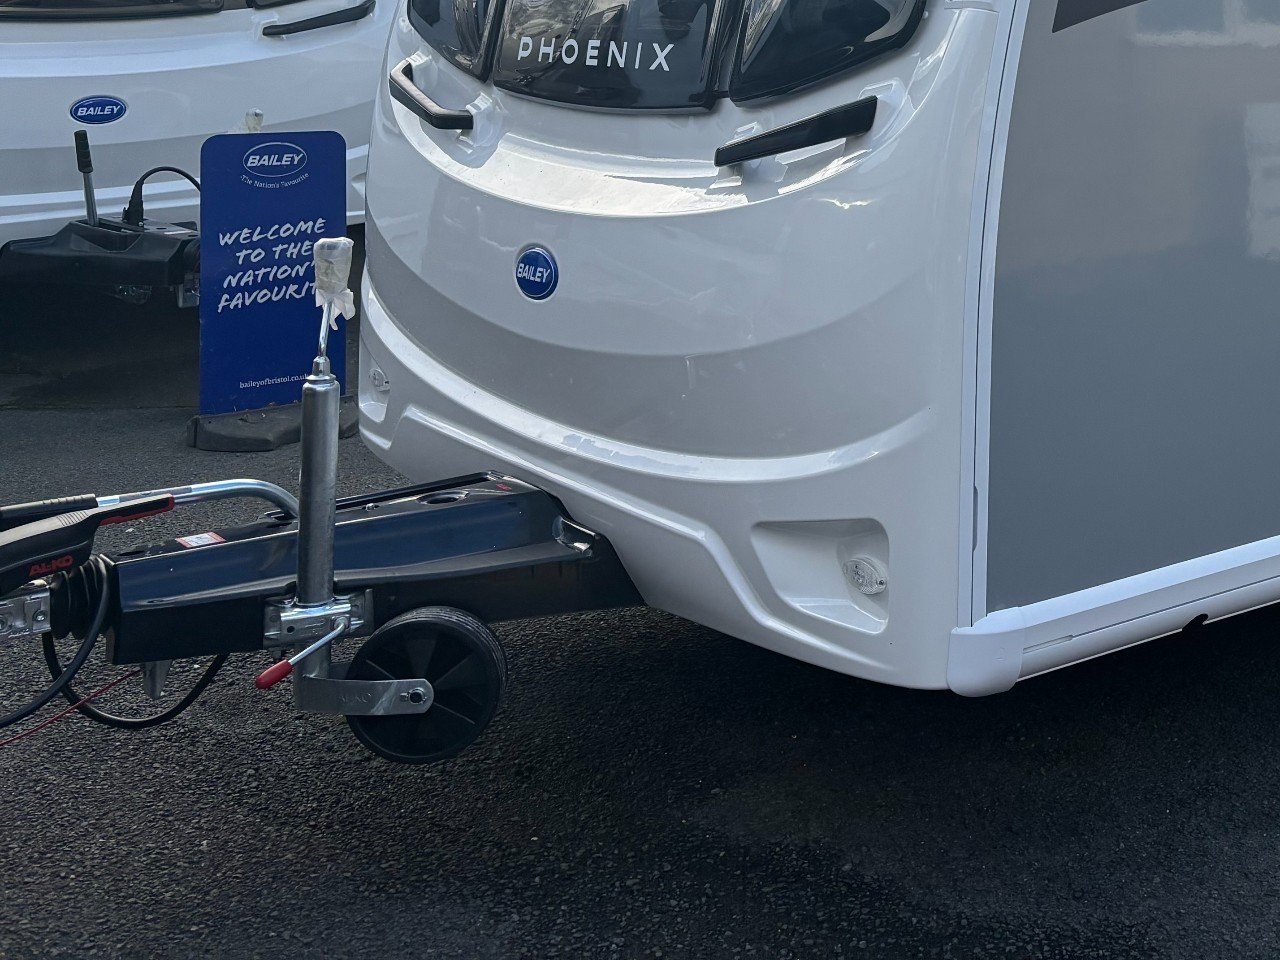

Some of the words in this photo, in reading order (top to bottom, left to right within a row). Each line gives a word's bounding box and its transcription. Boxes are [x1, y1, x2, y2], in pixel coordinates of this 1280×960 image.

[517, 36, 675, 72] PHOENIX
[77, 105, 120, 116] BAILEY
[246, 153, 304, 167] BAILEY
[219, 218, 326, 246] WELCOME
[236, 248, 266, 265] TO
[272, 240, 314, 260] THE
[223, 260, 315, 289] NATION'
[516, 262, 551, 283] BAILEY
[218, 281, 316, 313] FAVOURIT
